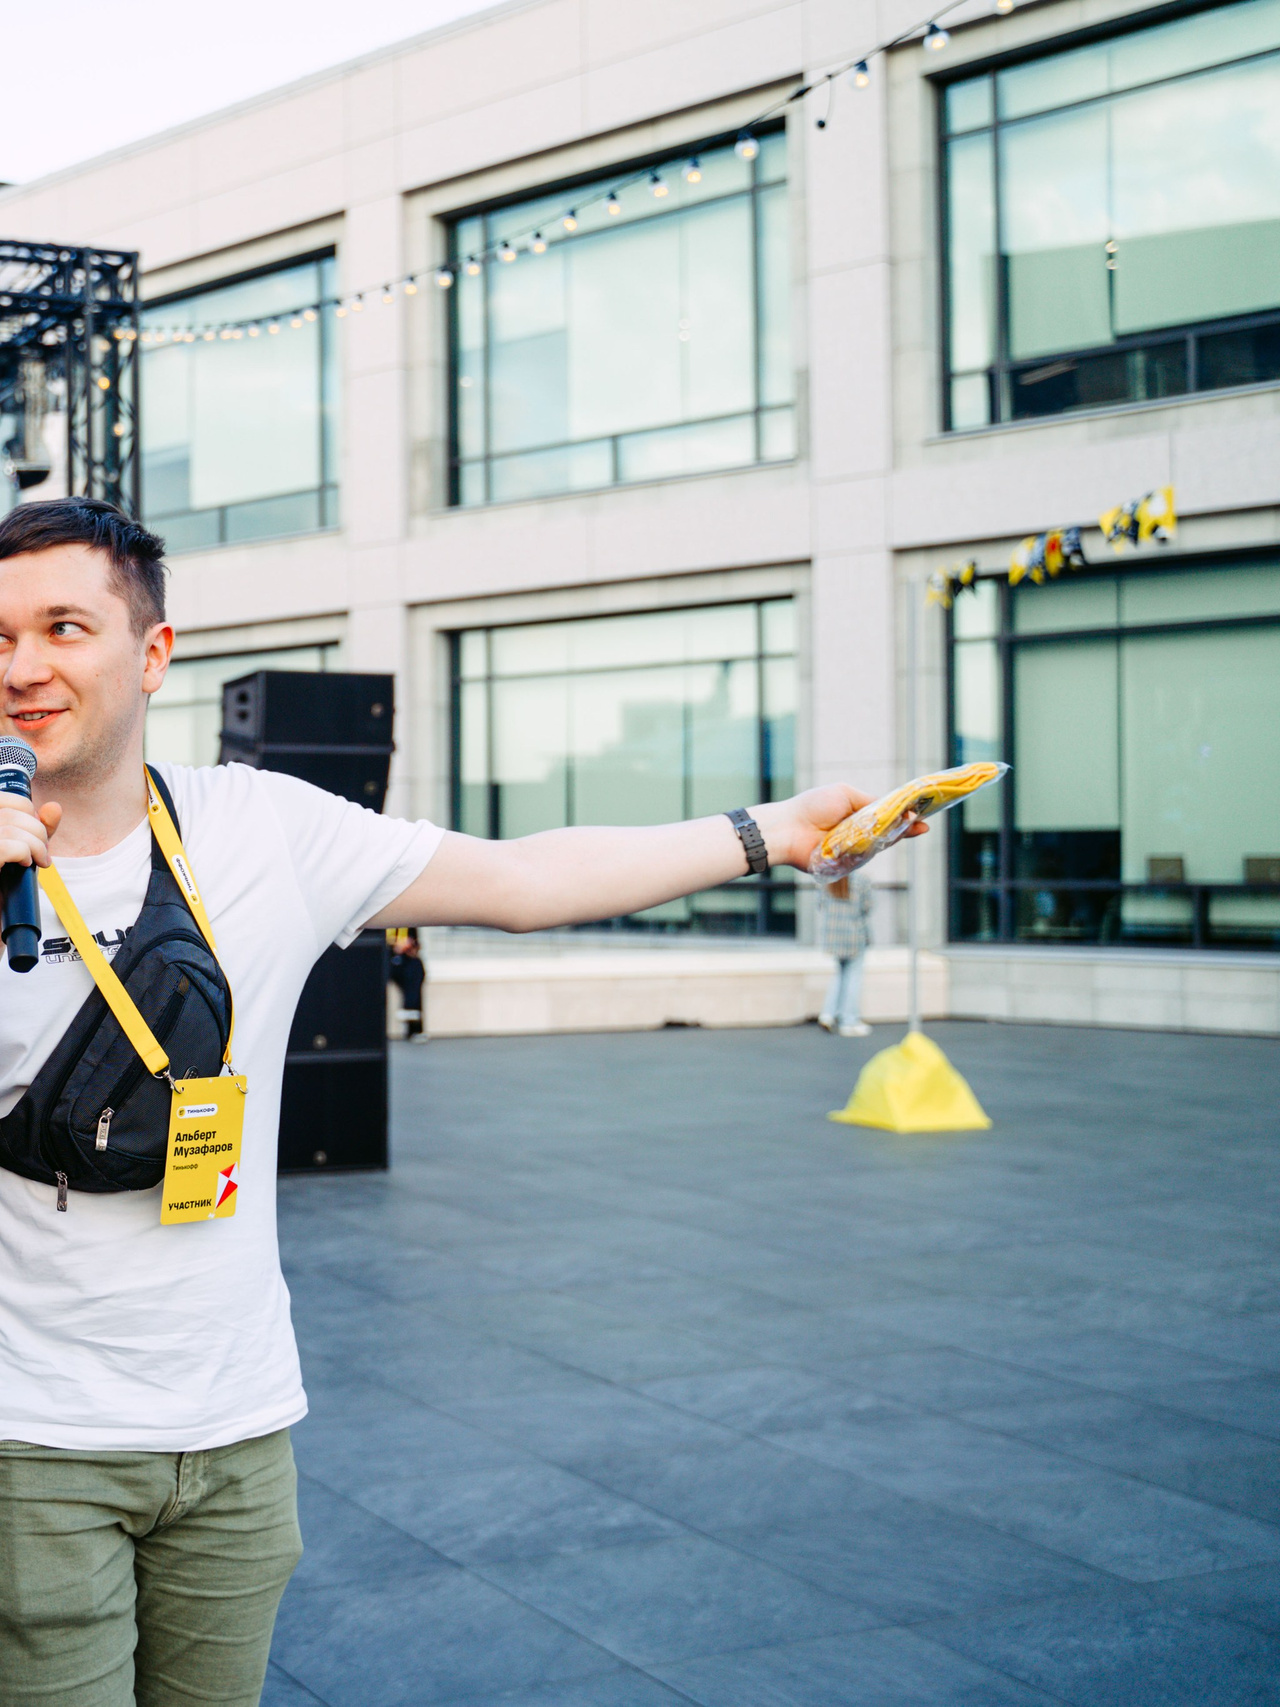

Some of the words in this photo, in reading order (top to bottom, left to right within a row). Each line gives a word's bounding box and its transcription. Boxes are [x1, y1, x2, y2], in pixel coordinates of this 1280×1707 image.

[175, 1130, 217, 1142] Альберт
[173, 1142, 233, 1157] Музафаров
[172, 1163, 199, 1171] Тинькофф
[168, 1199, 212, 1211] УЧАСТНИК
